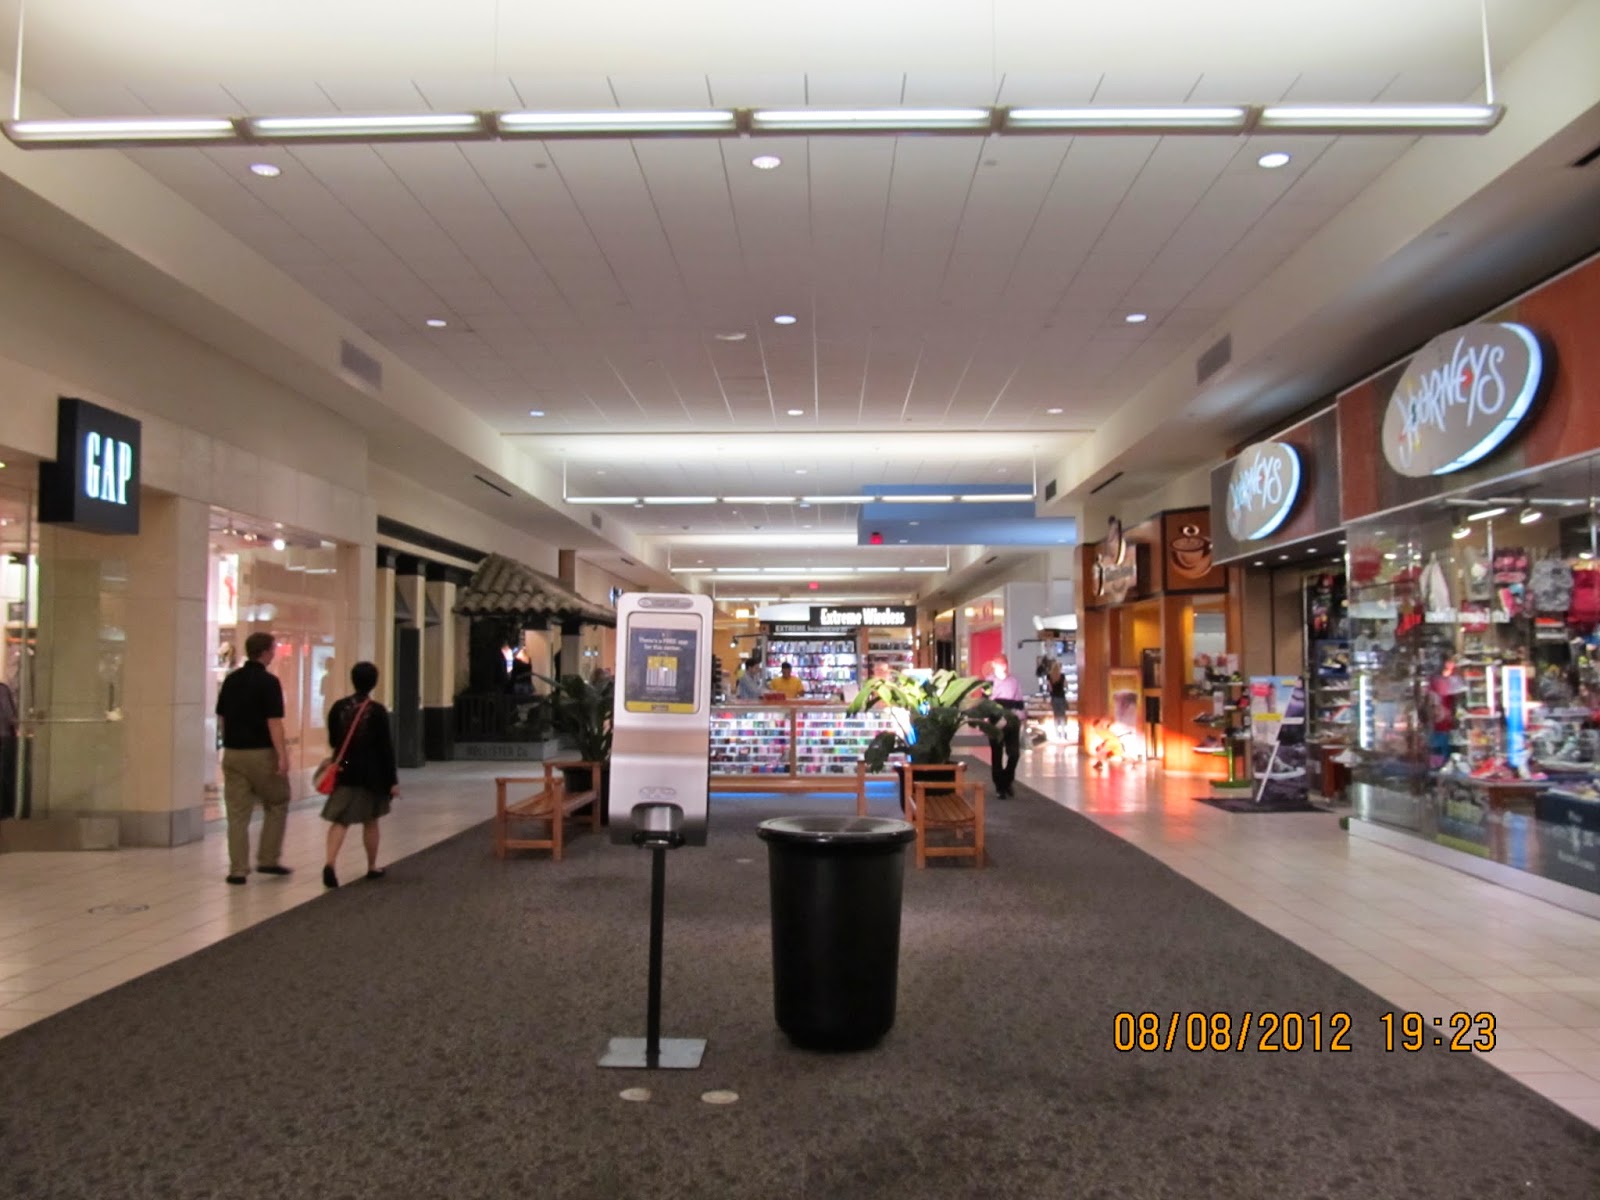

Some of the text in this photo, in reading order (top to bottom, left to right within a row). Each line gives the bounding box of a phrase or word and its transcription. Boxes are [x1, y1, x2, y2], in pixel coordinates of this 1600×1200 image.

[1395, 336, 1506, 469] JOURNEYS
[86, 431, 132, 505] GAP
[820, 607, 906, 626] Extreme Wireless
